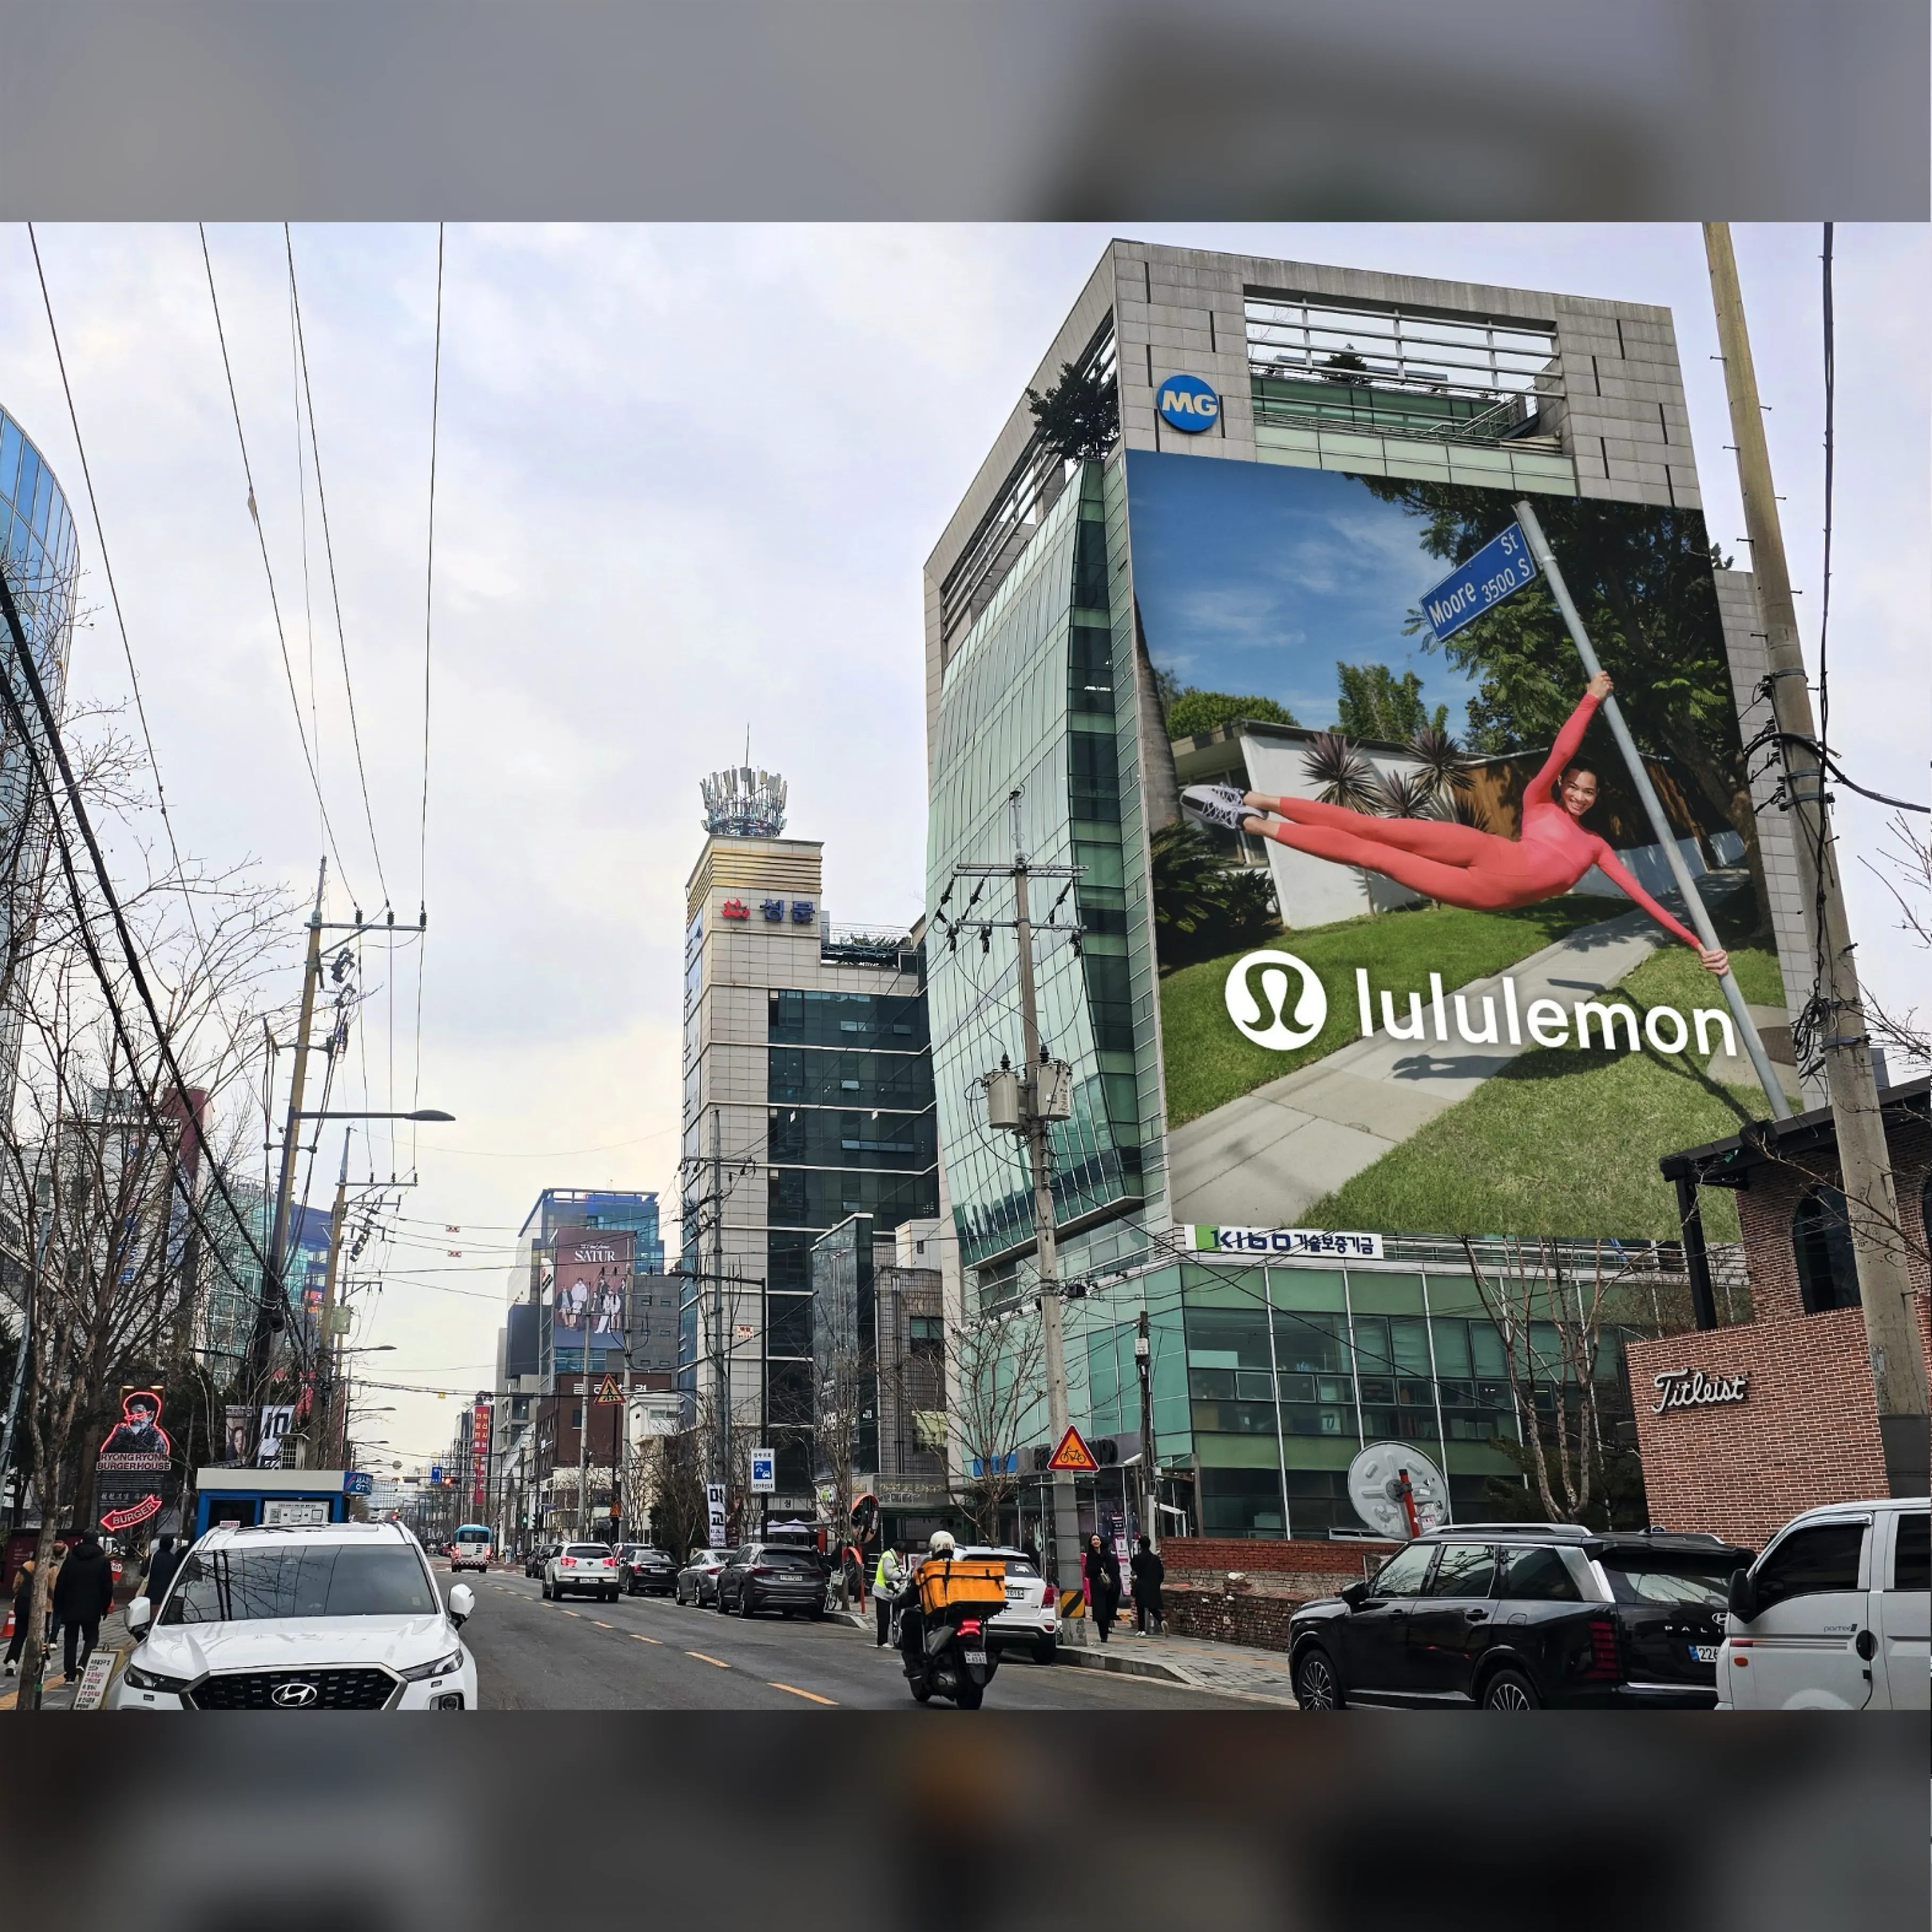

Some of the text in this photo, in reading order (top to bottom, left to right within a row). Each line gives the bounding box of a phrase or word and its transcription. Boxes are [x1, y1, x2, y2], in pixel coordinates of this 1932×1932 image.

[1162, 390, 1217, 416] MG
[1501, 532, 1519, 555] St
[1428, 558, 1530, 628] Moore 3500 S
[1355, 968, 1738, 1056] lululemon
[1294, 1233, 1374, 1255] 기술보증기금
[1650, 1368, 1747, 1414] Titleist
[112, 1502, 155, 1525] BURGER
